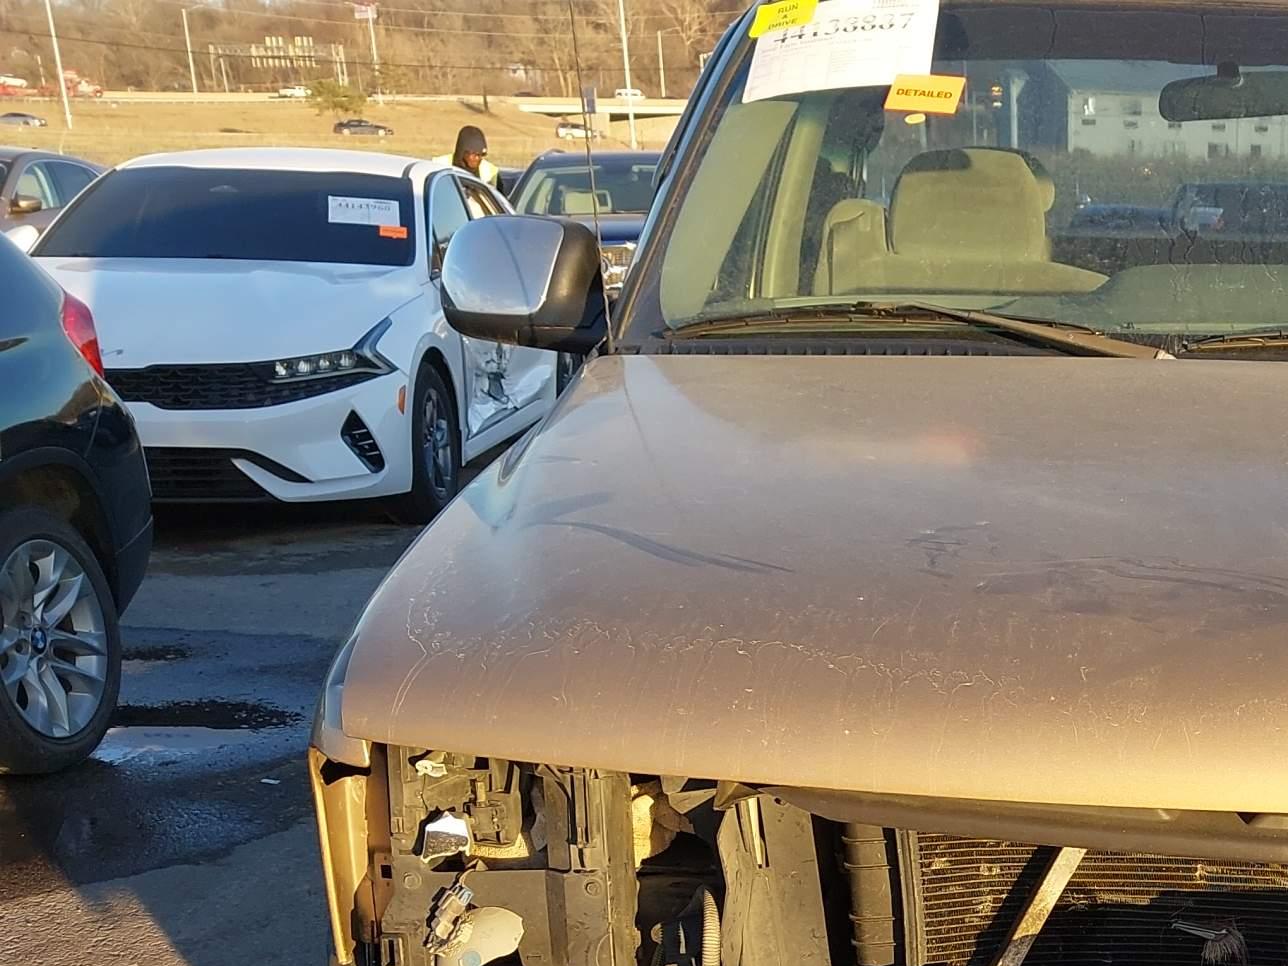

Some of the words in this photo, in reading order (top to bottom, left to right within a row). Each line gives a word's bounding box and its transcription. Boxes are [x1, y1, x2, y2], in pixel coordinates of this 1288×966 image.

[777, 3, 799, 14] RUN
[767, 18, 799, 30] DRIVE
[896, 87, 953, 100] DETAILED
